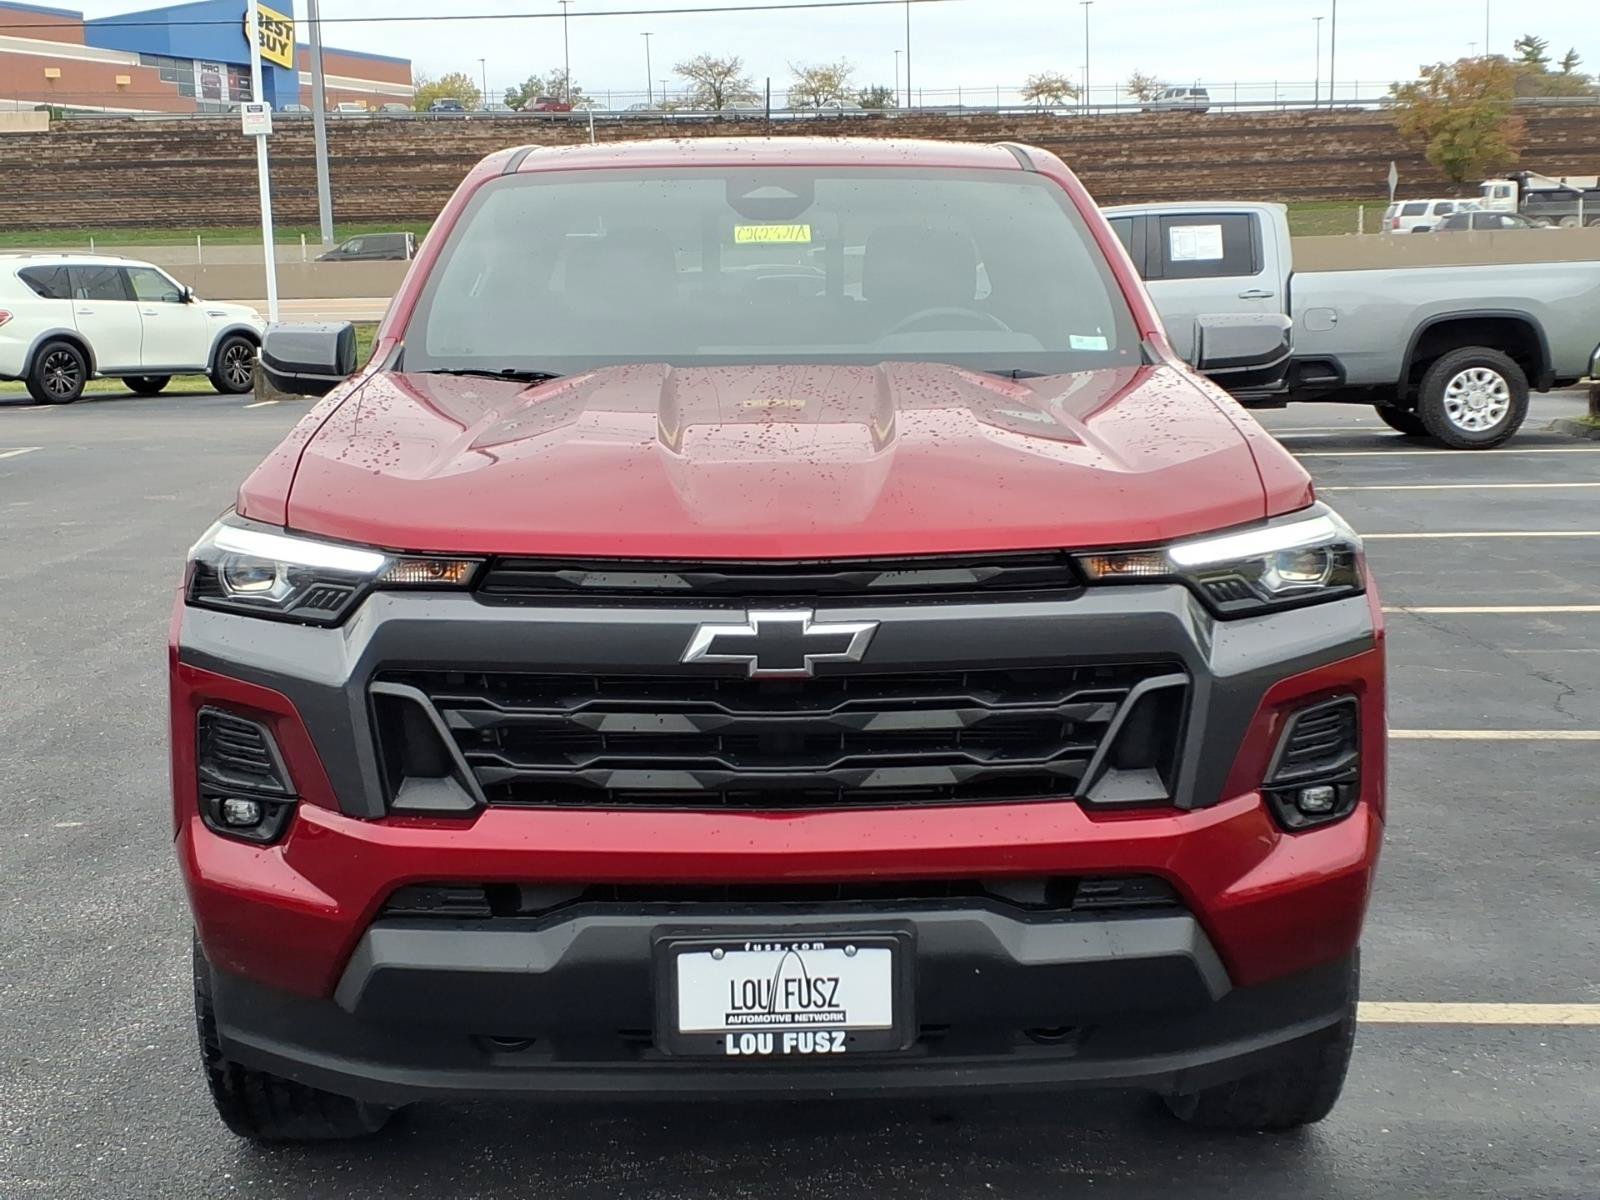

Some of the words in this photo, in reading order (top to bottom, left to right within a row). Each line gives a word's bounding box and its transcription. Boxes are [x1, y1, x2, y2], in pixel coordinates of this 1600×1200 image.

[257, 11, 293, 41] BEST
[258, 30, 290, 57] BUY
[744, 941, 825, 952] fusz.com
[730, 979, 772, 1011] LOU
[784, 976, 840, 1010] FUSZ
[727, 1014, 792, 1025] AUTOMOTIVE
[794, 1012, 844, 1023] NETWORK
[726, 1033, 774, 1055] LOU
[783, 1031, 846, 1054] FUSZ
